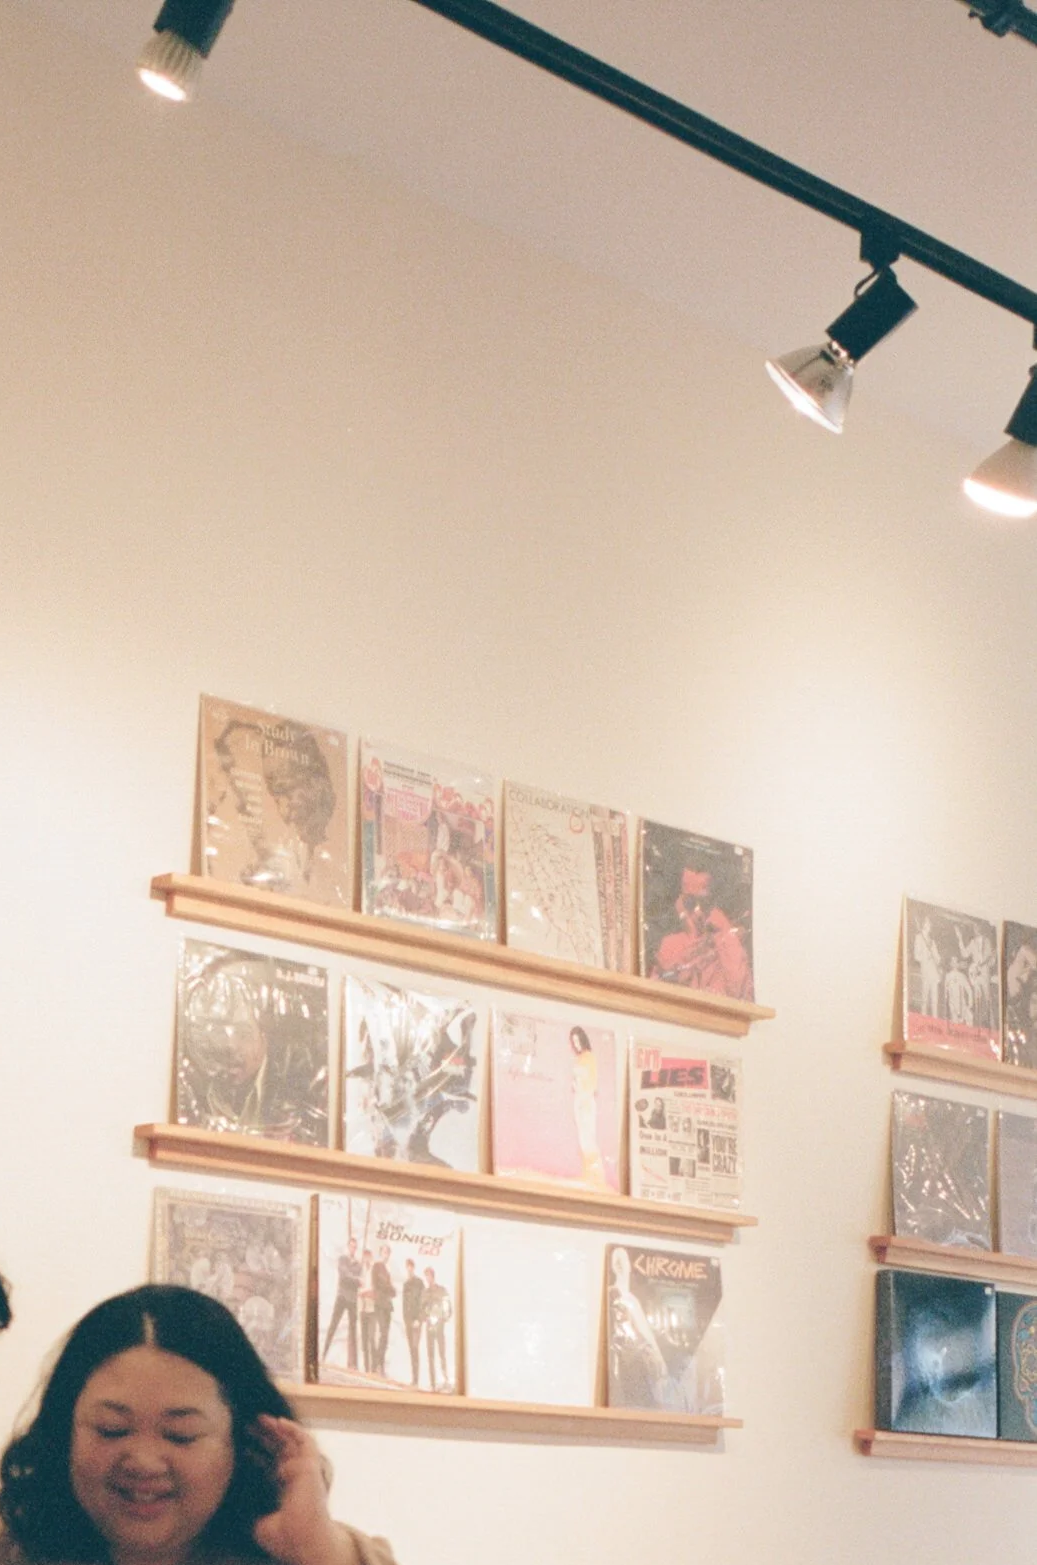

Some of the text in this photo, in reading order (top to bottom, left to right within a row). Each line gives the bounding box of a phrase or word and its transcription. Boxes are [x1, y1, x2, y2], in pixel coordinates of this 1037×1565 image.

[257, 720, 299, 744] Study
[263, 738, 311, 767] Brown
[508, 787, 591, 820] COLLABORATION
[640, 1065, 706, 1090] LIES
[375, 1229, 445, 1248] SONICS
[633, 1253, 709, 1280] CHROME
